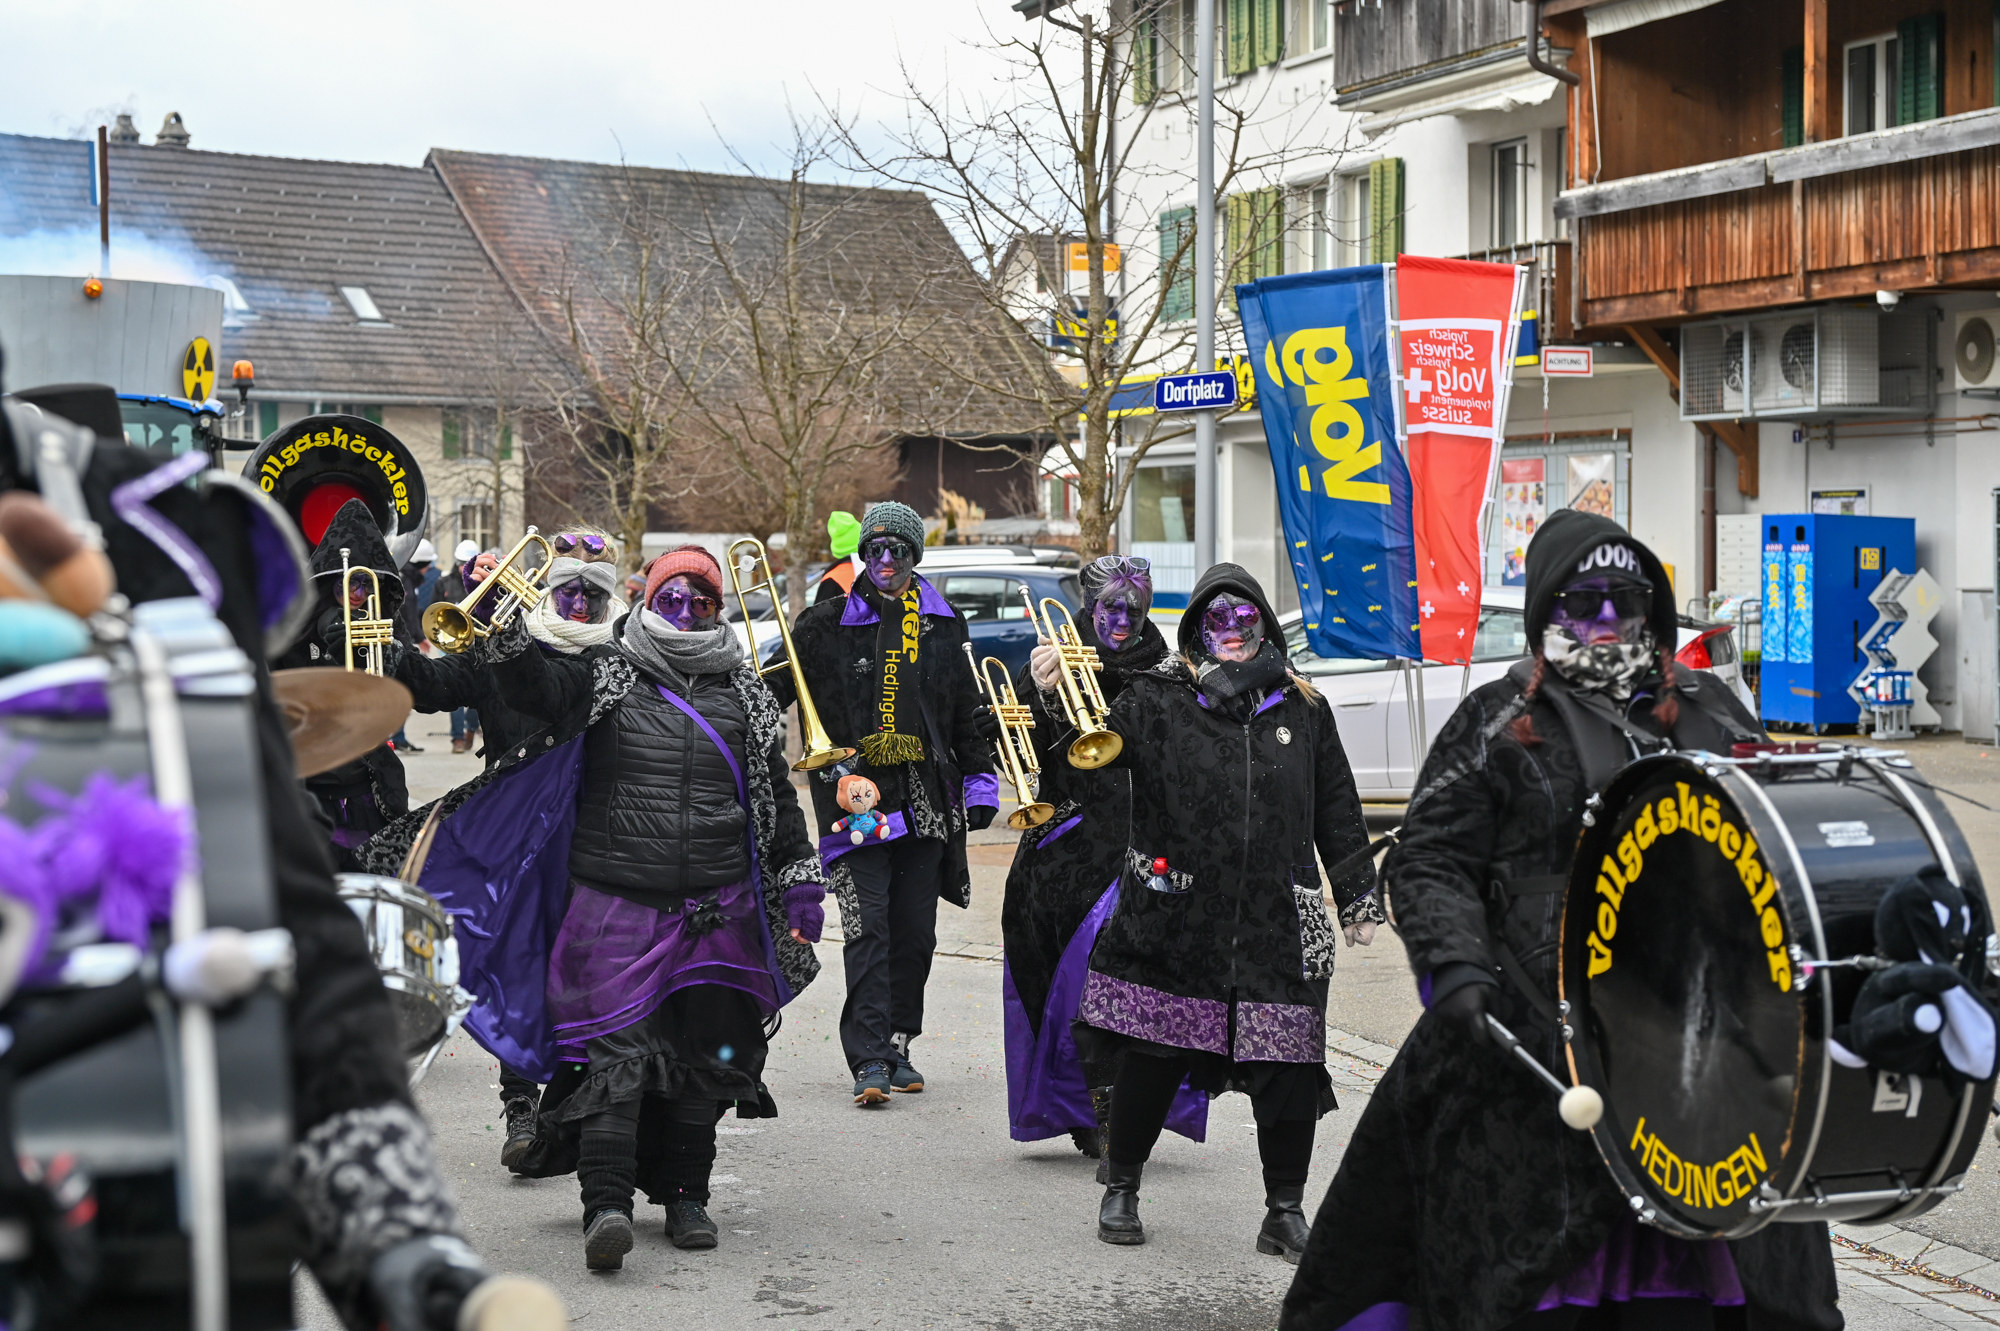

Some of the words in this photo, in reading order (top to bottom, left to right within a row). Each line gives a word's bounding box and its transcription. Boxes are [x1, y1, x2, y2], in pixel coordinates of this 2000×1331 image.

[1163, 378, 1226, 406] Dorfplatz
[1548, 357, 1581, 366] ACHTUNG
[253, 426, 410, 516] ollgashöckler
[878, 650, 901, 733] Hedingen
[1586, 781, 1792, 993] Vollgashöckler
[1630, 1116, 1768, 1209] HEDINGEN
